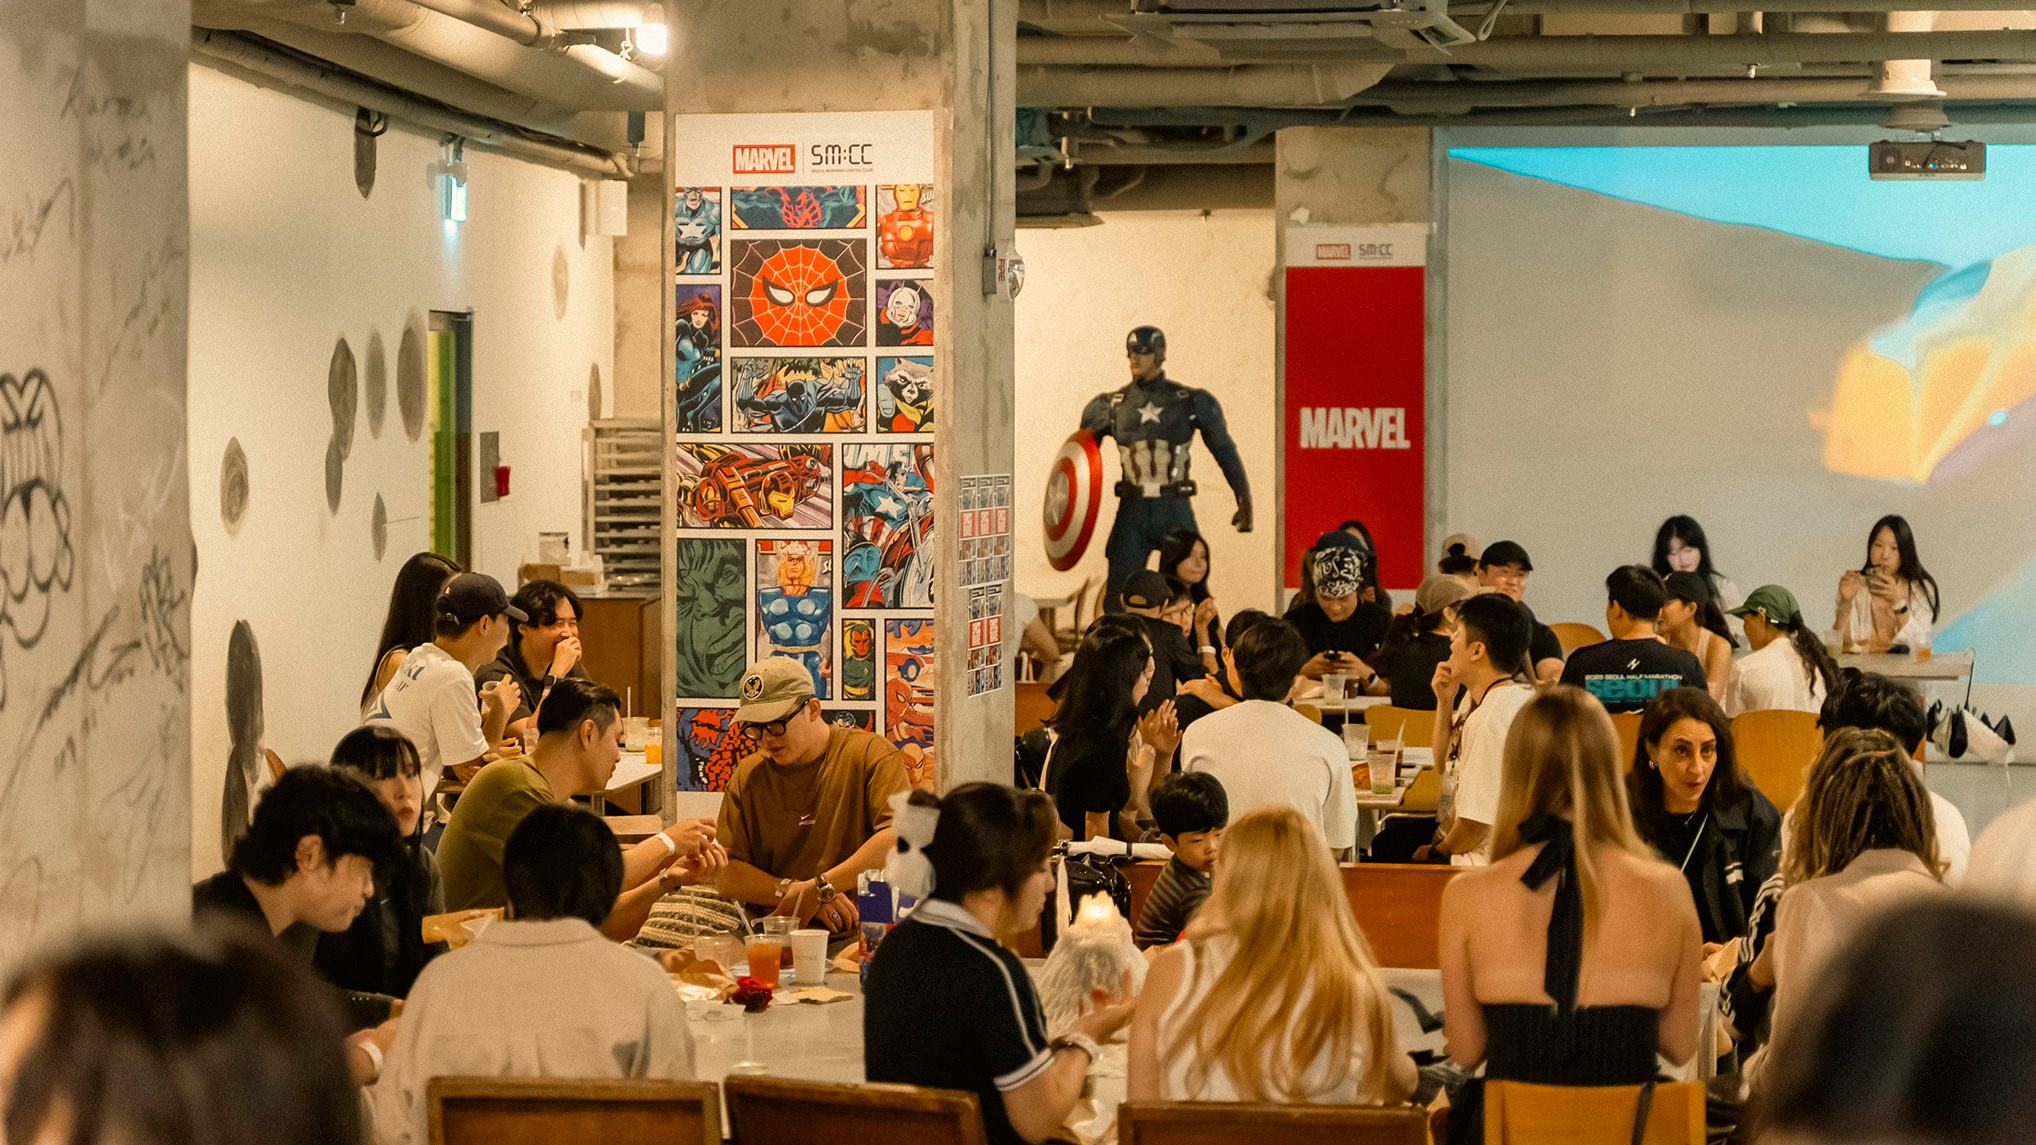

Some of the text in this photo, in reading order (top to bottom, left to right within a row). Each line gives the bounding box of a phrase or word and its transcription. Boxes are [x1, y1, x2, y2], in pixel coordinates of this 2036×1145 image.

[735, 147, 795, 172] MARVEL
[1317, 245, 1350, 259] MARVEL
[998, 258, 1006, 283] FIRE
[1300, 407, 1411, 449] MARVEL
